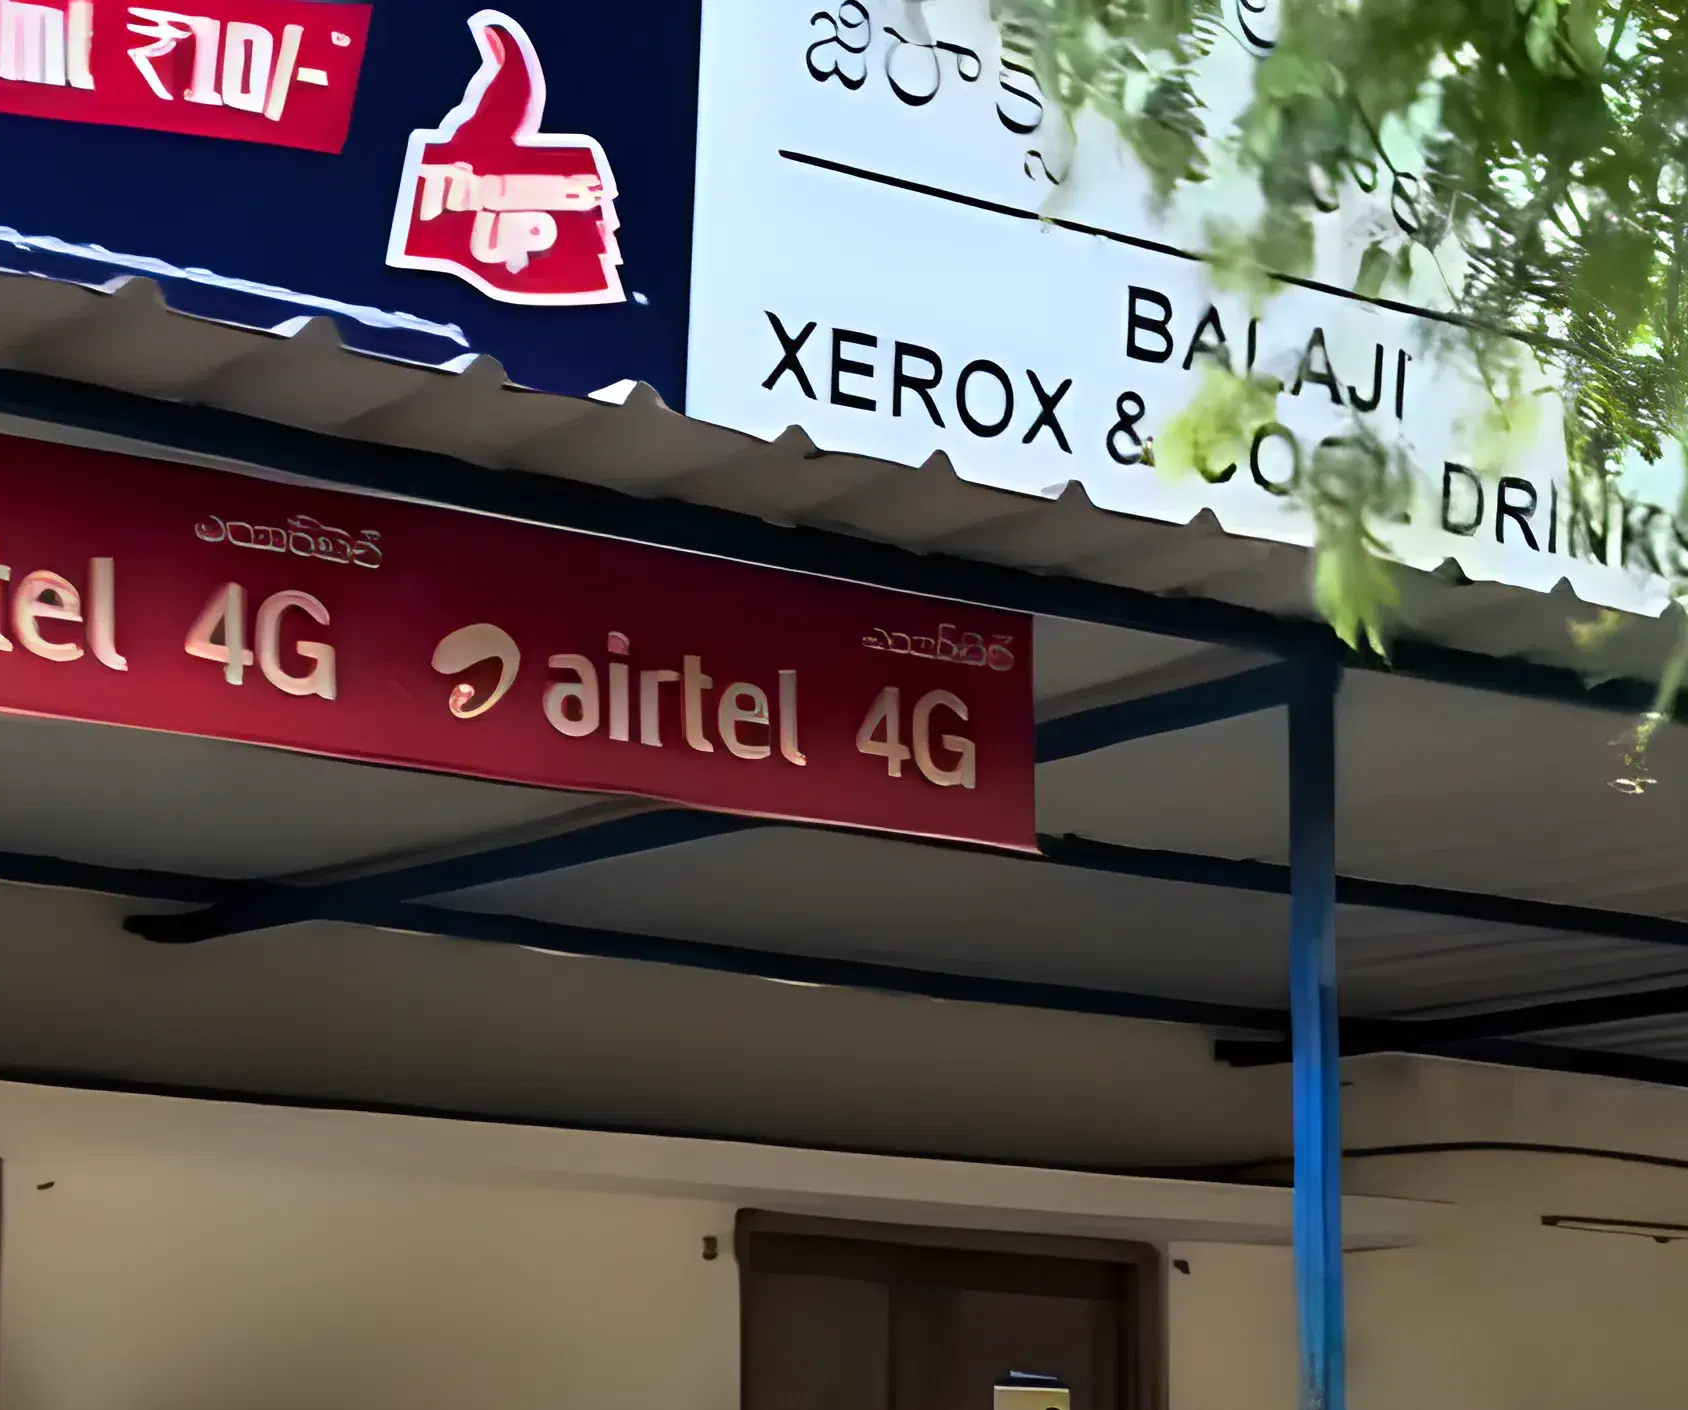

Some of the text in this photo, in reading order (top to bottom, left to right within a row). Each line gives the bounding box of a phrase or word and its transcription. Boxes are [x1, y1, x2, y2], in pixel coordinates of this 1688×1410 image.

[763, 310, 1074, 455] XEROX
[1105, 390, 1150, 467] &
[1125, 284, 1408, 421] BALAJI
[183, 581, 337, 701] 4G
[542, 630, 977, 789] airtel 4G
